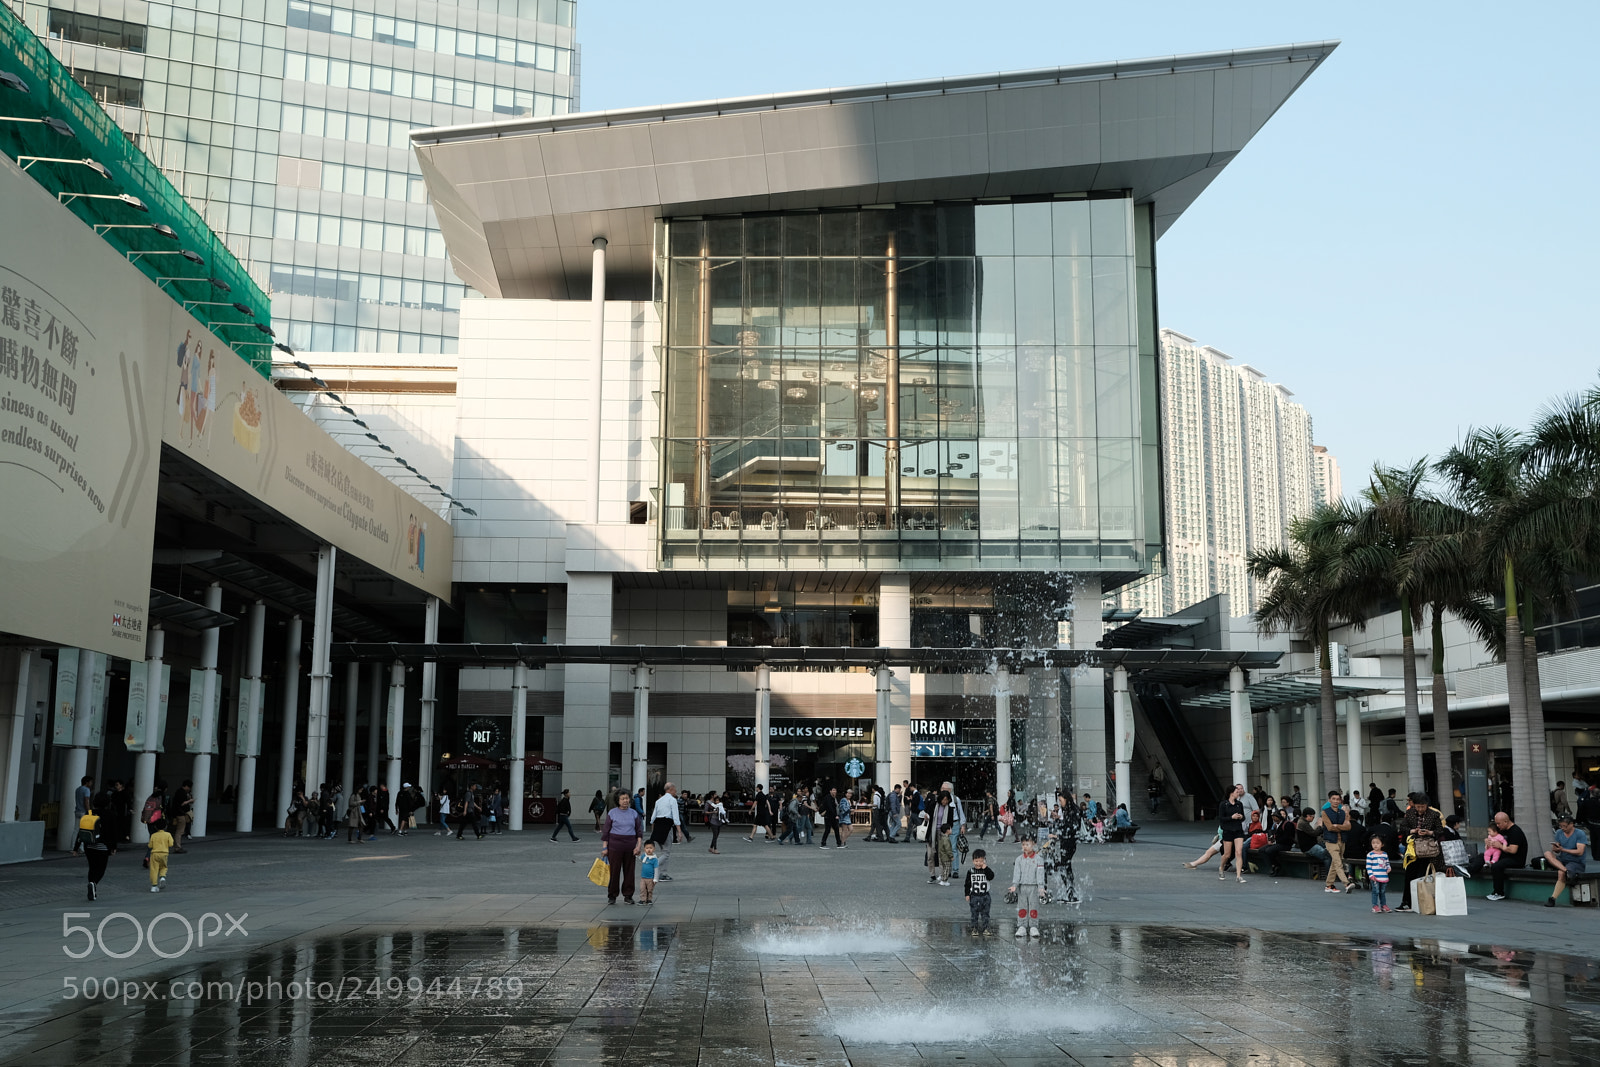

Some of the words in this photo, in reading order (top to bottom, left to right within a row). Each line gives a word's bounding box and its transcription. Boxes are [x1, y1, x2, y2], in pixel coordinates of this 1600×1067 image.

[1, 286, 79, 371] 驚喜不斷
[0, 336, 78, 416] 購物無間
[37, 410, 49, 427] as
[50, 417, 79, 452] usual
[1, 425, 43, 453] endless
[44, 442, 88, 492] surprises
[88, 486, 105, 514] now
[285, 466, 305, 491] Discover
[305, 485, 317, 499] more
[316, 495, 337, 512] surprises
[337, 504, 342, 516] at
[342, 501, 368, 531] Citygate
[368, 517, 389, 543] Outlets
[473, 731, 491, 743] PRET
[735, 726, 812, 737] STABUCKS
[815, 727, 864, 737] COFFEE
[910, 720, 956, 735] URBAN
[972, 882, 987, 894] 69
